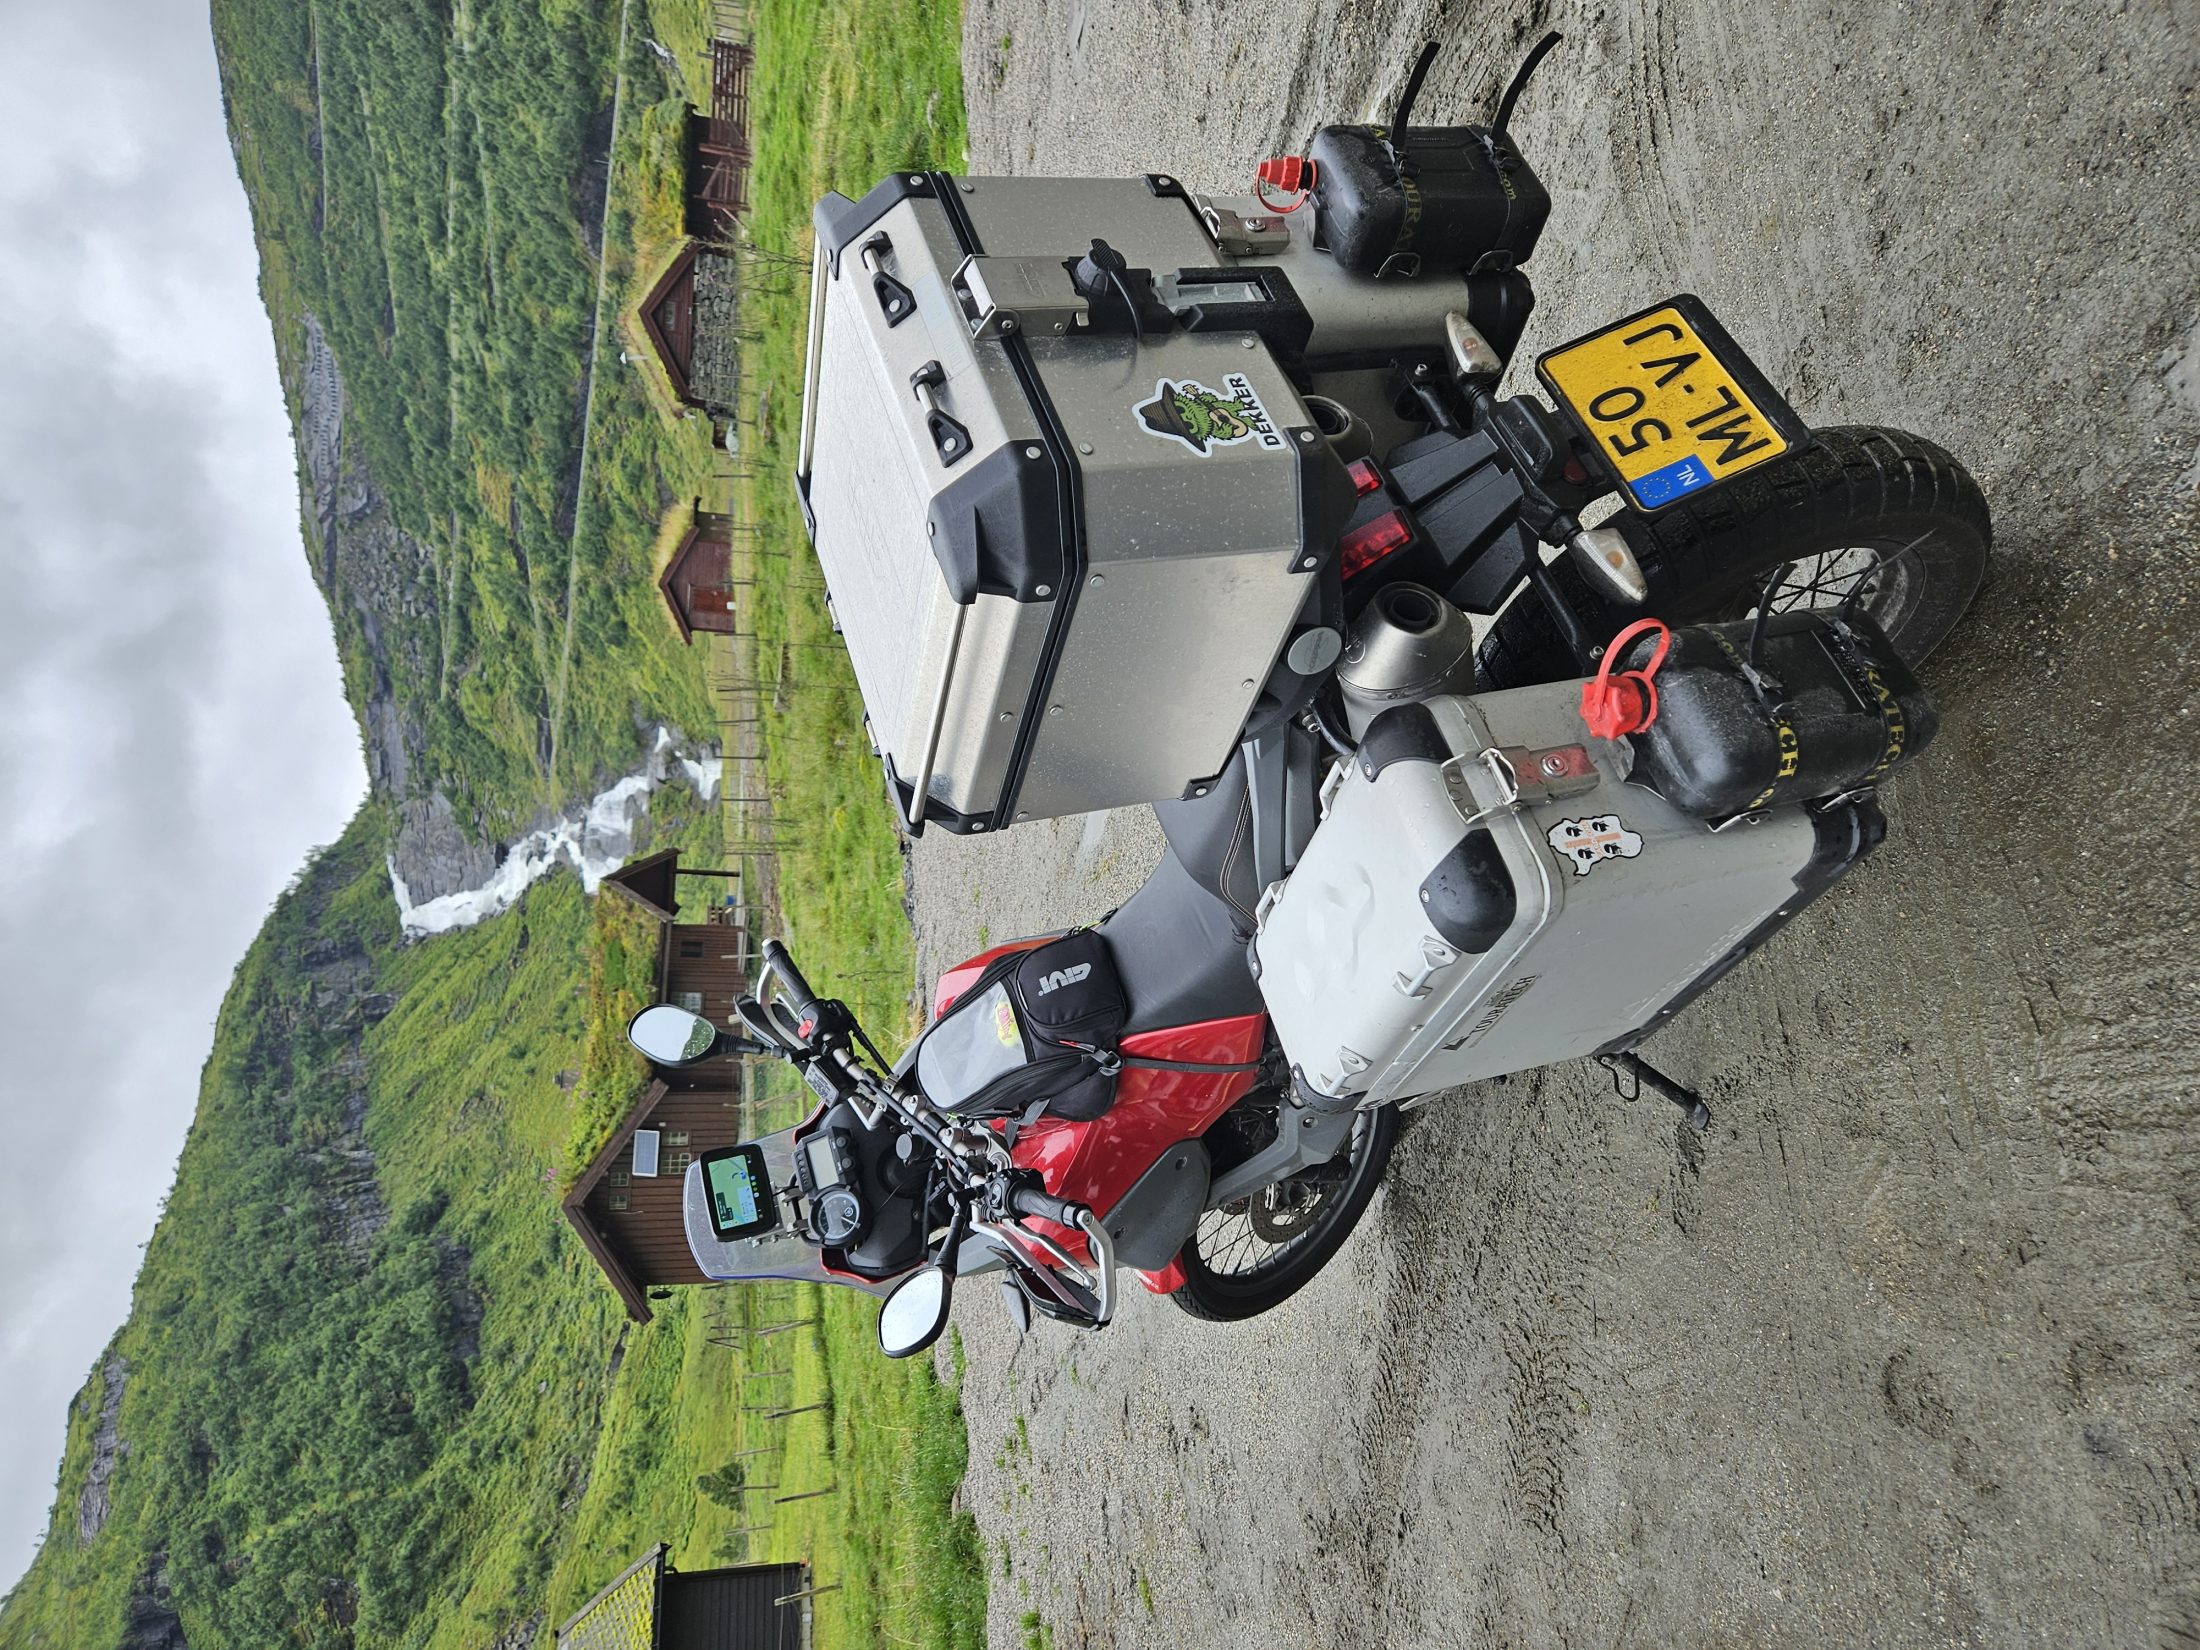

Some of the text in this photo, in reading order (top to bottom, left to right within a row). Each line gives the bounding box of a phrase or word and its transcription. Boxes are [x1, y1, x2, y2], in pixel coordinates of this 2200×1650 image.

[1228, 376, 1281, 446] DEKKER
[1588, 386, 1672, 457] 50
[1622, 322, 1772, 466] ML-VJ
[1676, 464, 1700, 487] NL
[1468, 974, 1537, 1036] TOURATECH
